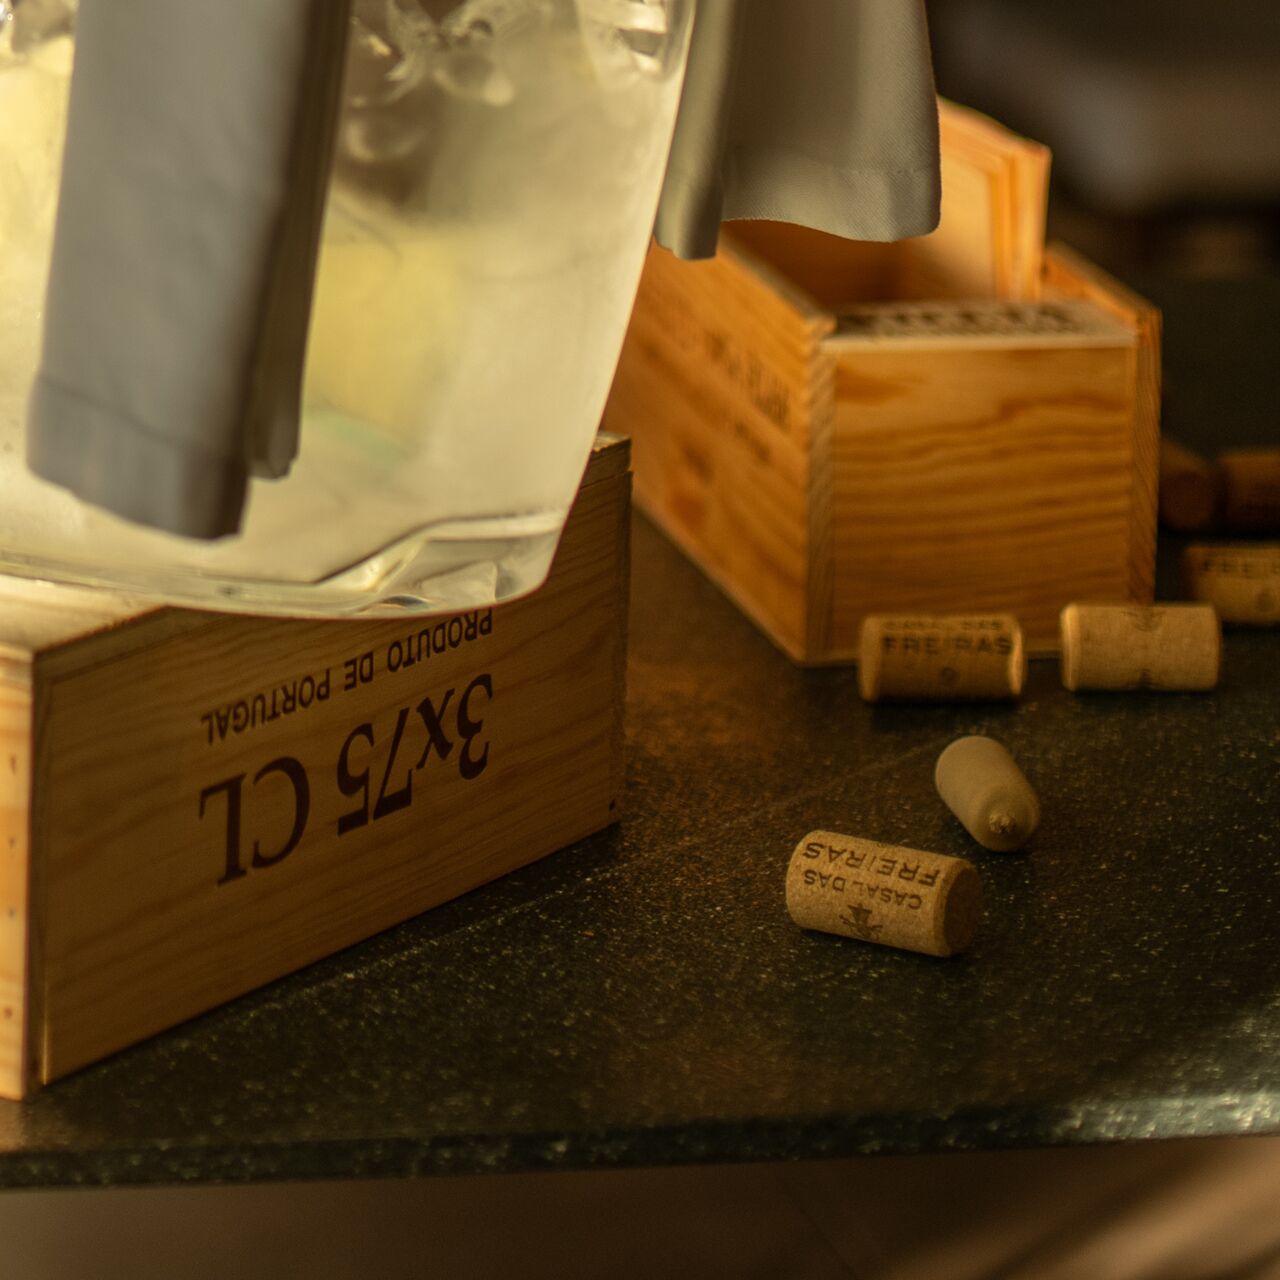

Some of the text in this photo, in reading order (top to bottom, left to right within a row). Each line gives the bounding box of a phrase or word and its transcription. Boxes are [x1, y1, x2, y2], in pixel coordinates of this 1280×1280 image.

[200, 607, 493, 746] PRODUTO DE PORTUGAL
[199, 756, 311, 888] CL
[803, 842, 941, 887] FREIRAS
[803, 869, 923, 911] CASAL DAS
